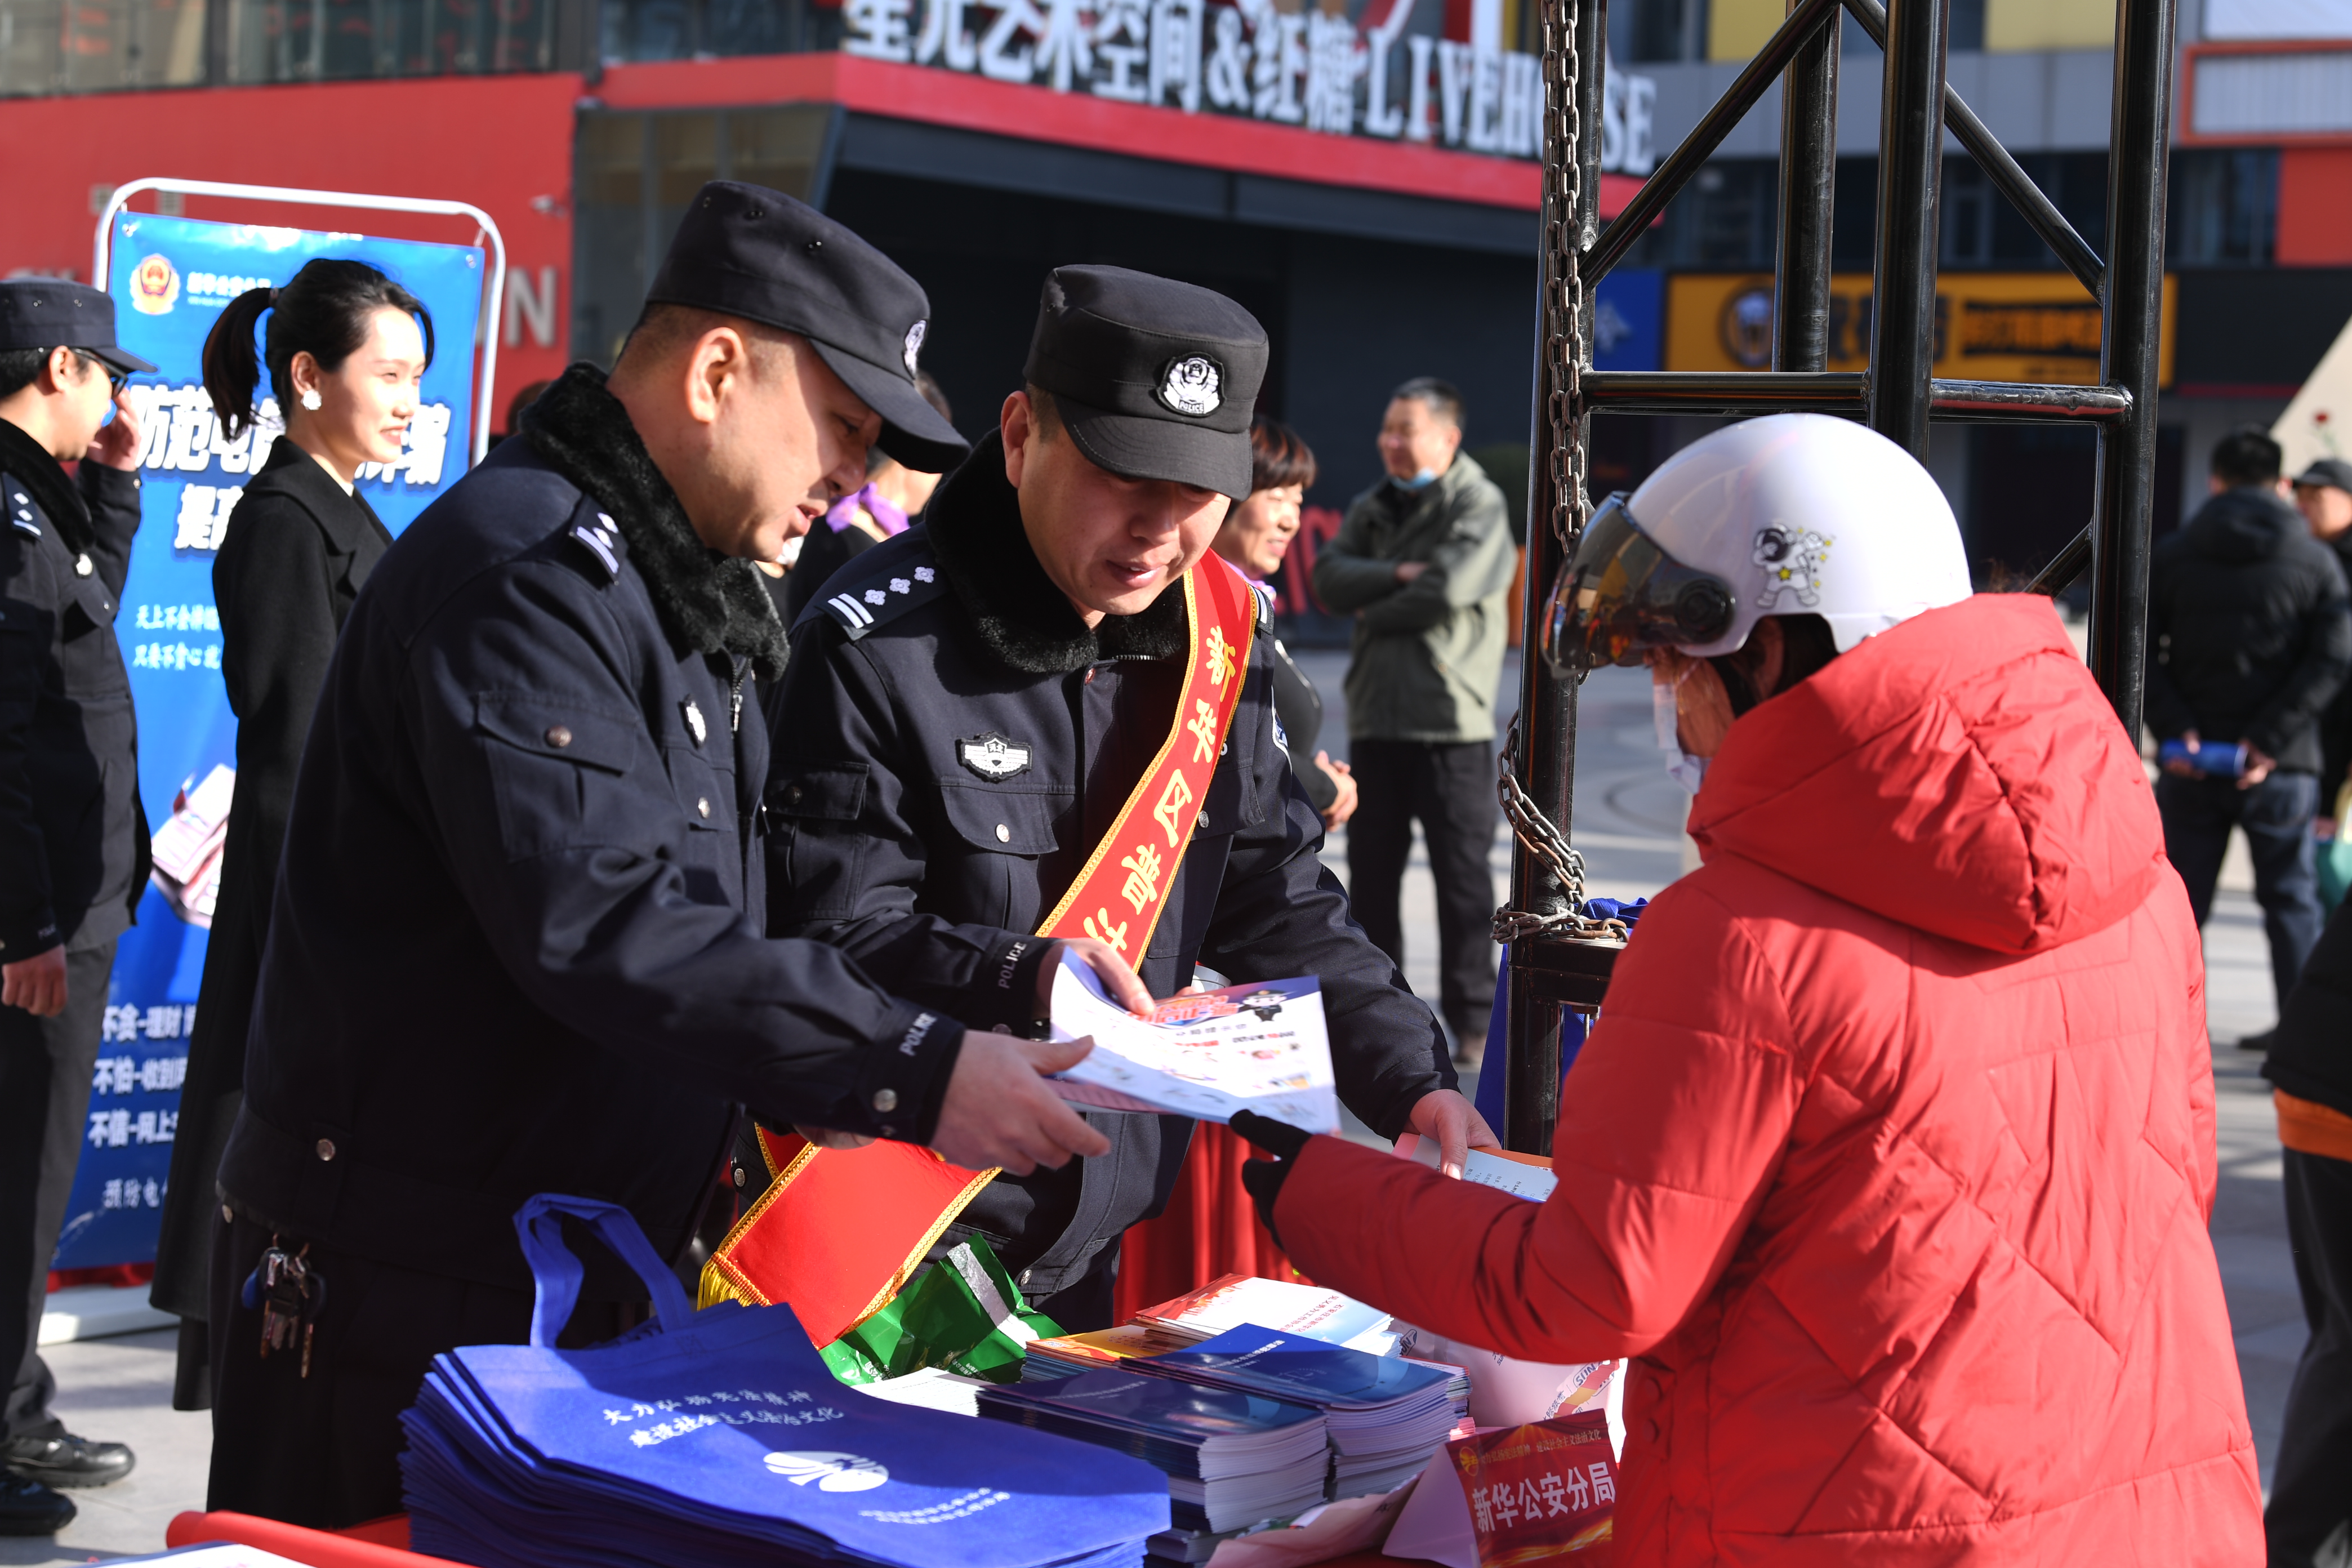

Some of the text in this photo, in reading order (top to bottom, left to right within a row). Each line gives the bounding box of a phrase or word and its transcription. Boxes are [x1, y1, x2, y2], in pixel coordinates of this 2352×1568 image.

[998, 942, 1027, 989] POLICE
[1536, 1429, 1602, 1453] 建设社会主义法治文化
[1472, 1461, 1616, 1533] 新华公安分局
